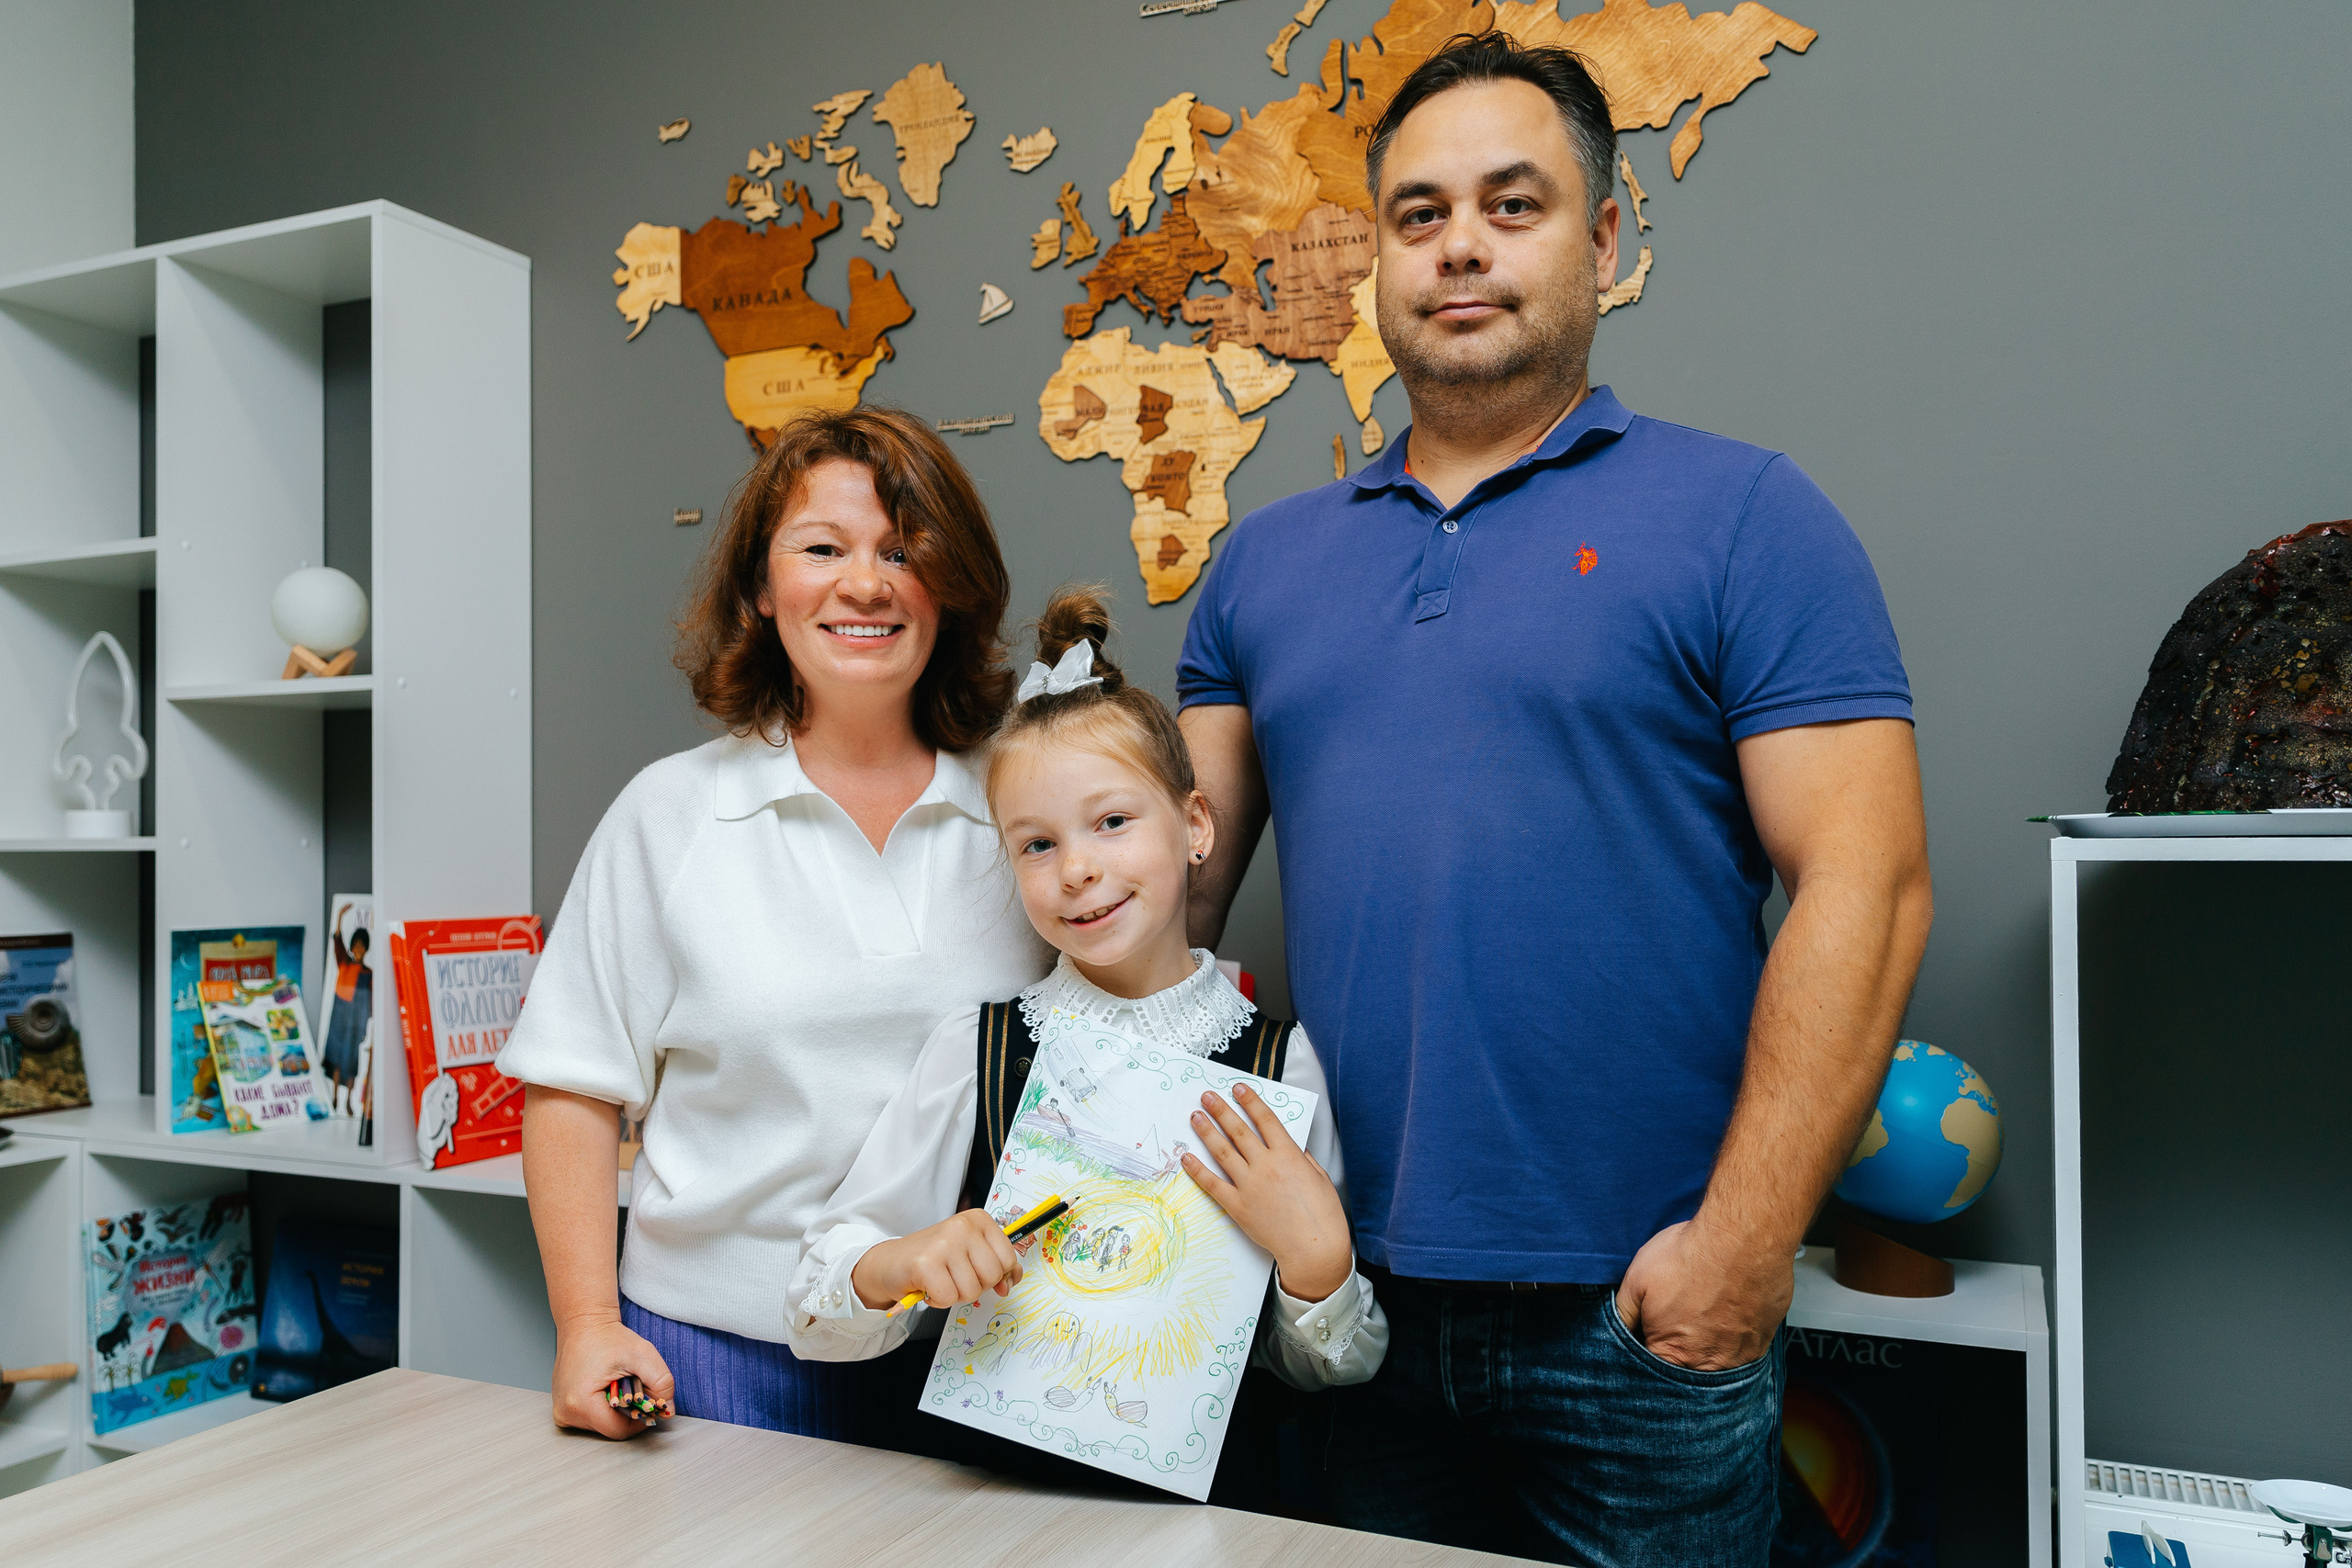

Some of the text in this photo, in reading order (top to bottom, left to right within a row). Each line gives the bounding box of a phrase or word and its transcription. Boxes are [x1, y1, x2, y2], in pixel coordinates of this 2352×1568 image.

[1291, 233, 1368, 253] КАЗАХСТАН
[634, 261, 674, 279] США
[712, 288, 792, 311] КАНАДА
[763, 378, 806, 397] США
[435, 953, 522, 989] ИСТОРИЯ
[447, 1032, 477, 1061] ДЛЯ
[481, 1027, 514, 1056] ДЕТ
[133, 1268, 196, 1296] ЖИЗНИ
[1785, 1325, 1903, 1369] Атлас
